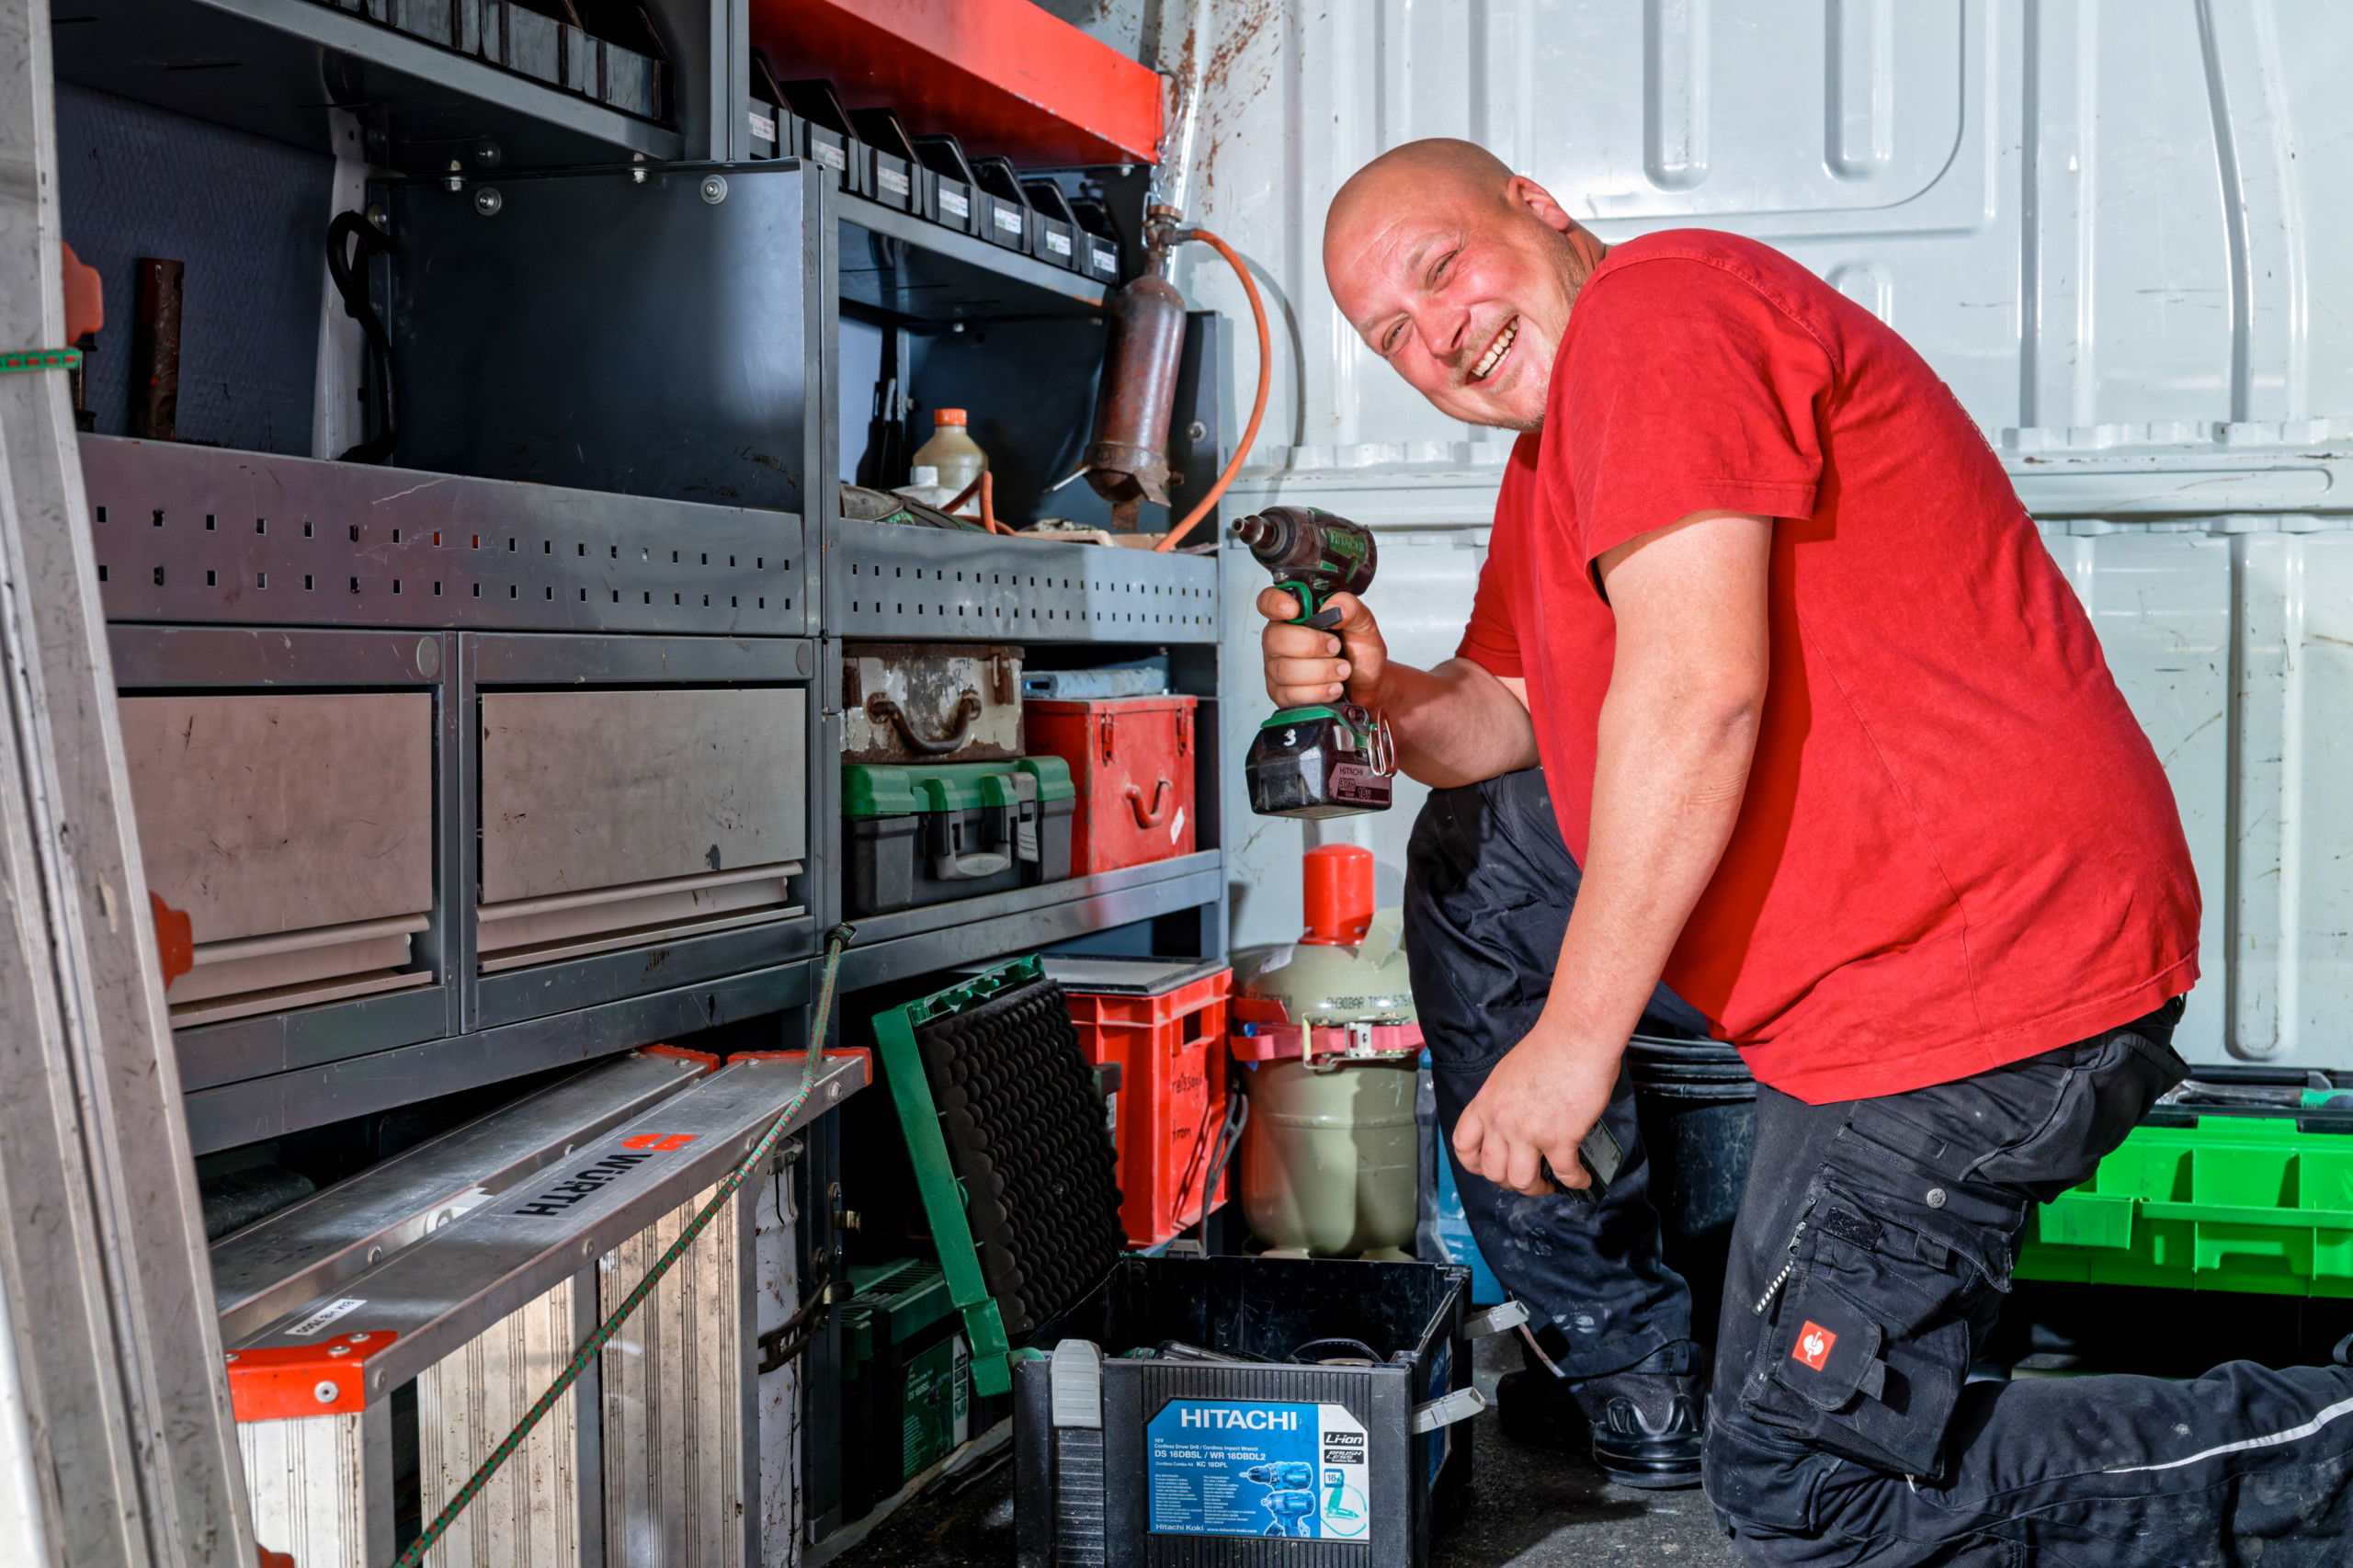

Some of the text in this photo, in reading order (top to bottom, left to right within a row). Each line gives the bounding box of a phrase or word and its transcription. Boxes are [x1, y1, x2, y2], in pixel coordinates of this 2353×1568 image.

[1283, 728, 1297, 747] 3
[1339, 767, 1364, 777] HITACHI
[513, 1153, 654, 1216] WÜRTH
[1180, 1408, 1297, 1431] HITACHI
[1325, 1434, 1363, 1444] Li-ion
[1169, 1450, 1202, 1459] 18DBSL
[1210, 1451, 1224, 1460] WR
[1227, 1452, 1266, 1461] 18DBDL2
[1155, 1523, 1185, 1531] Hitachi
[1186, 1524, 1204, 1532] Koki
